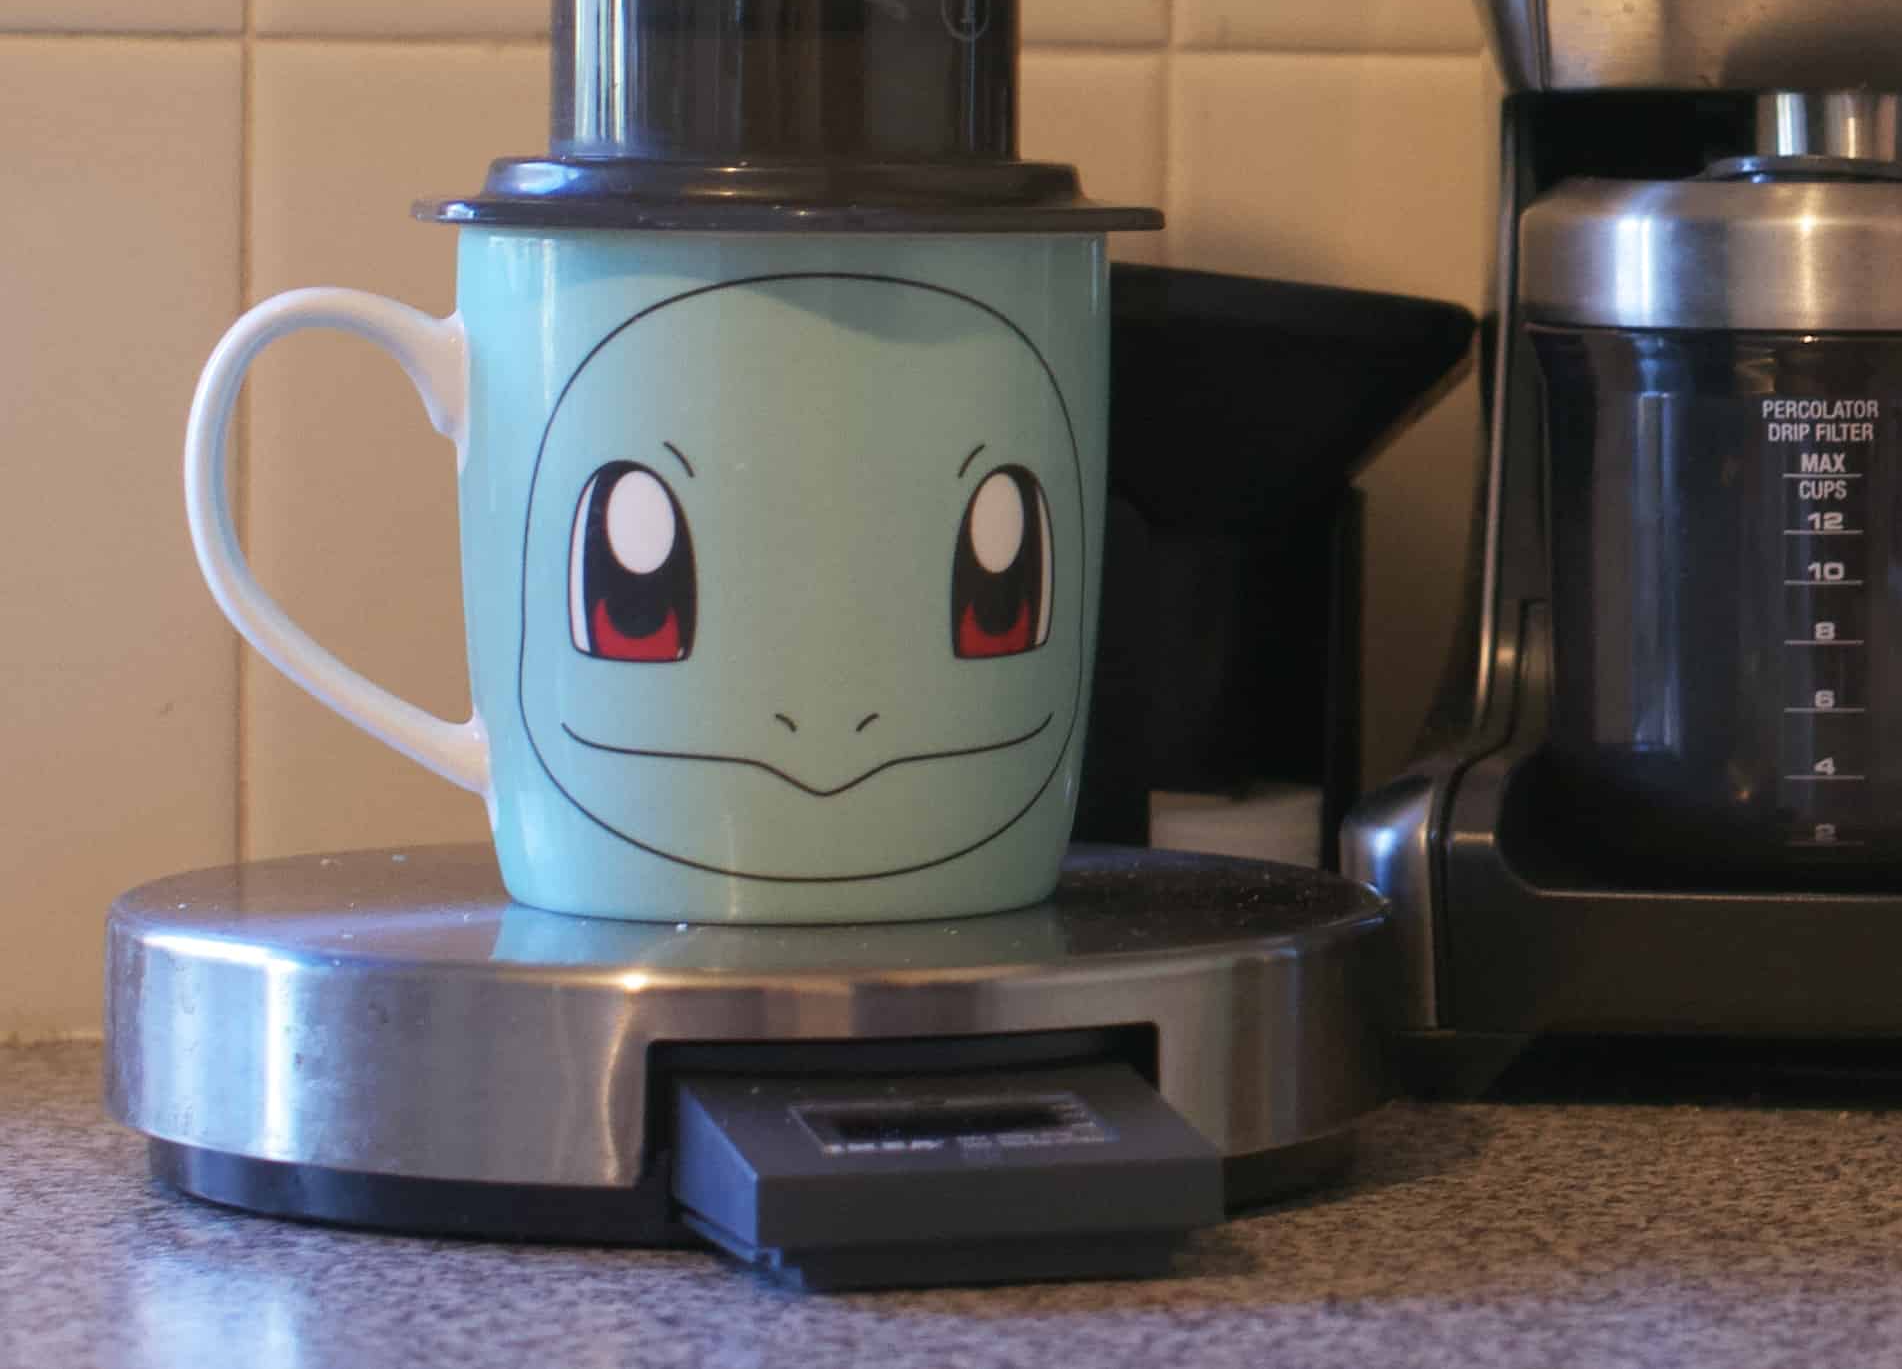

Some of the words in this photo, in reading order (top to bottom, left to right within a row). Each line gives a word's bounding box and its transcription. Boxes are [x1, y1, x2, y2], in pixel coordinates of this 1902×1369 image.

[1762, 400, 1880, 419] PERCOLATOR
[1768, 423, 1811, 442] DRIP
[1815, 423, 1874, 442] FILTER
[1801, 453, 1845, 473] MAX
[1798, 480, 1848, 500] CUPS
[1807, 512, 1844, 531] 12
[1807, 562, 1845, 581] 10
[1815, 622, 1835, 640] 8
[1814, 690, 1835, 708] 6
[1813, 757, 1835, 775] 4
[1814, 824, 1836, 842] 2
